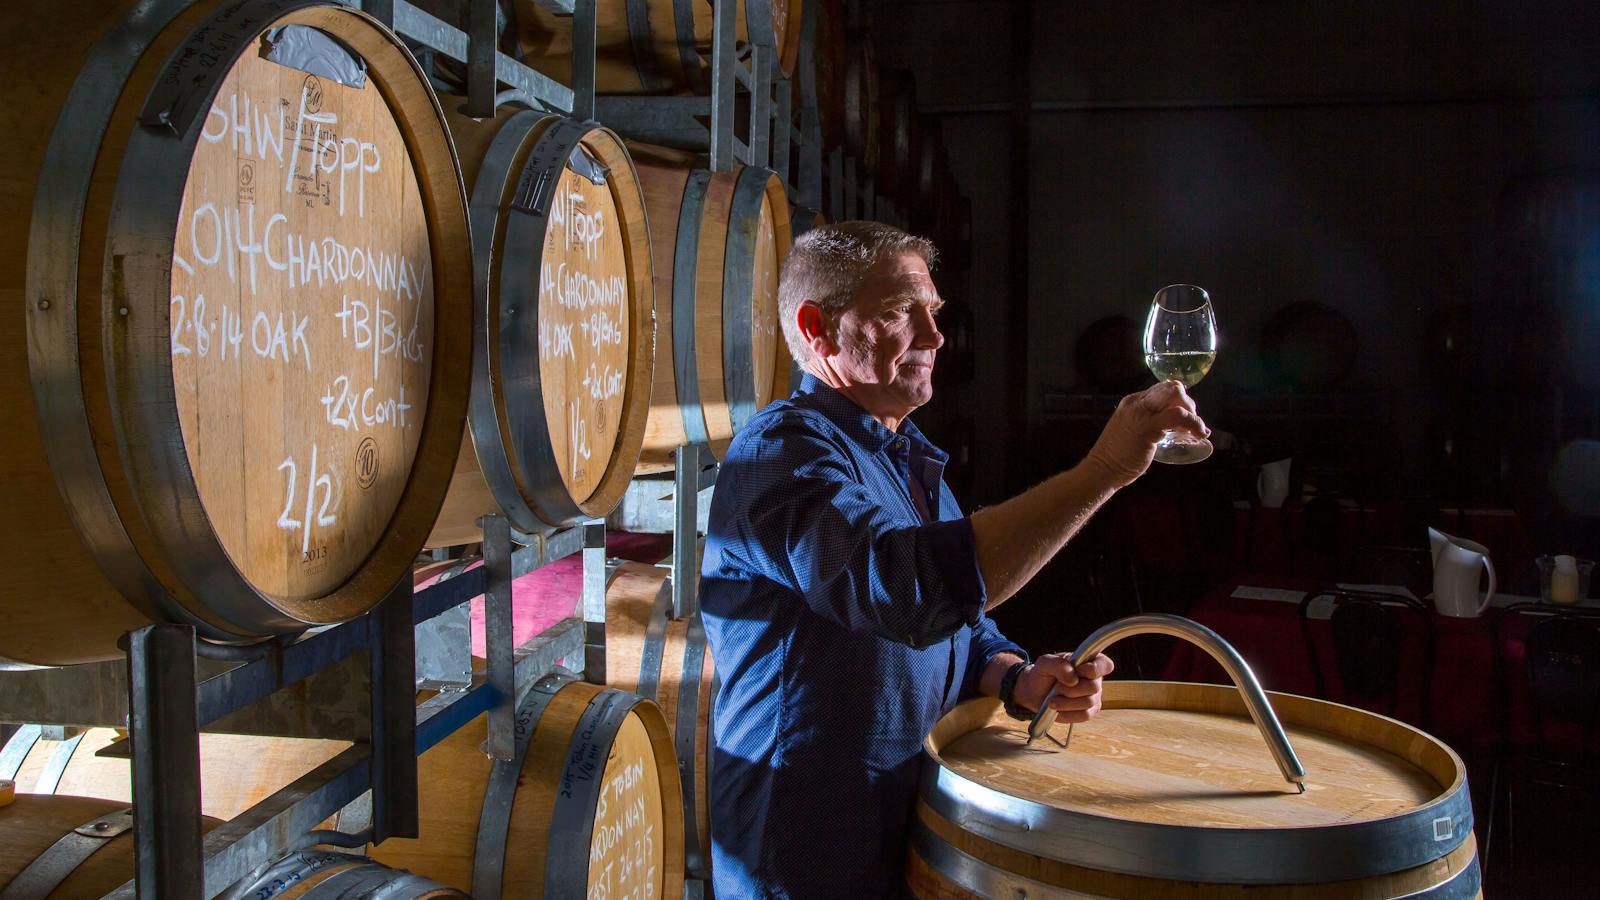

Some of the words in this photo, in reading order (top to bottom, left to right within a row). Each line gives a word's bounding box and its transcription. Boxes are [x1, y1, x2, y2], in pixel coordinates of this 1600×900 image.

[263, 212, 427, 334] CHARDONNAY
[557, 261, 625, 325] CHARDONNAY
[251, 310, 312, 375] OAK
[553, 322, 576, 365] OAK
[277, 438, 338, 562] 2/2
[302, 545, 328, 564] 2013
[611, 757, 644, 802] TOBIN
